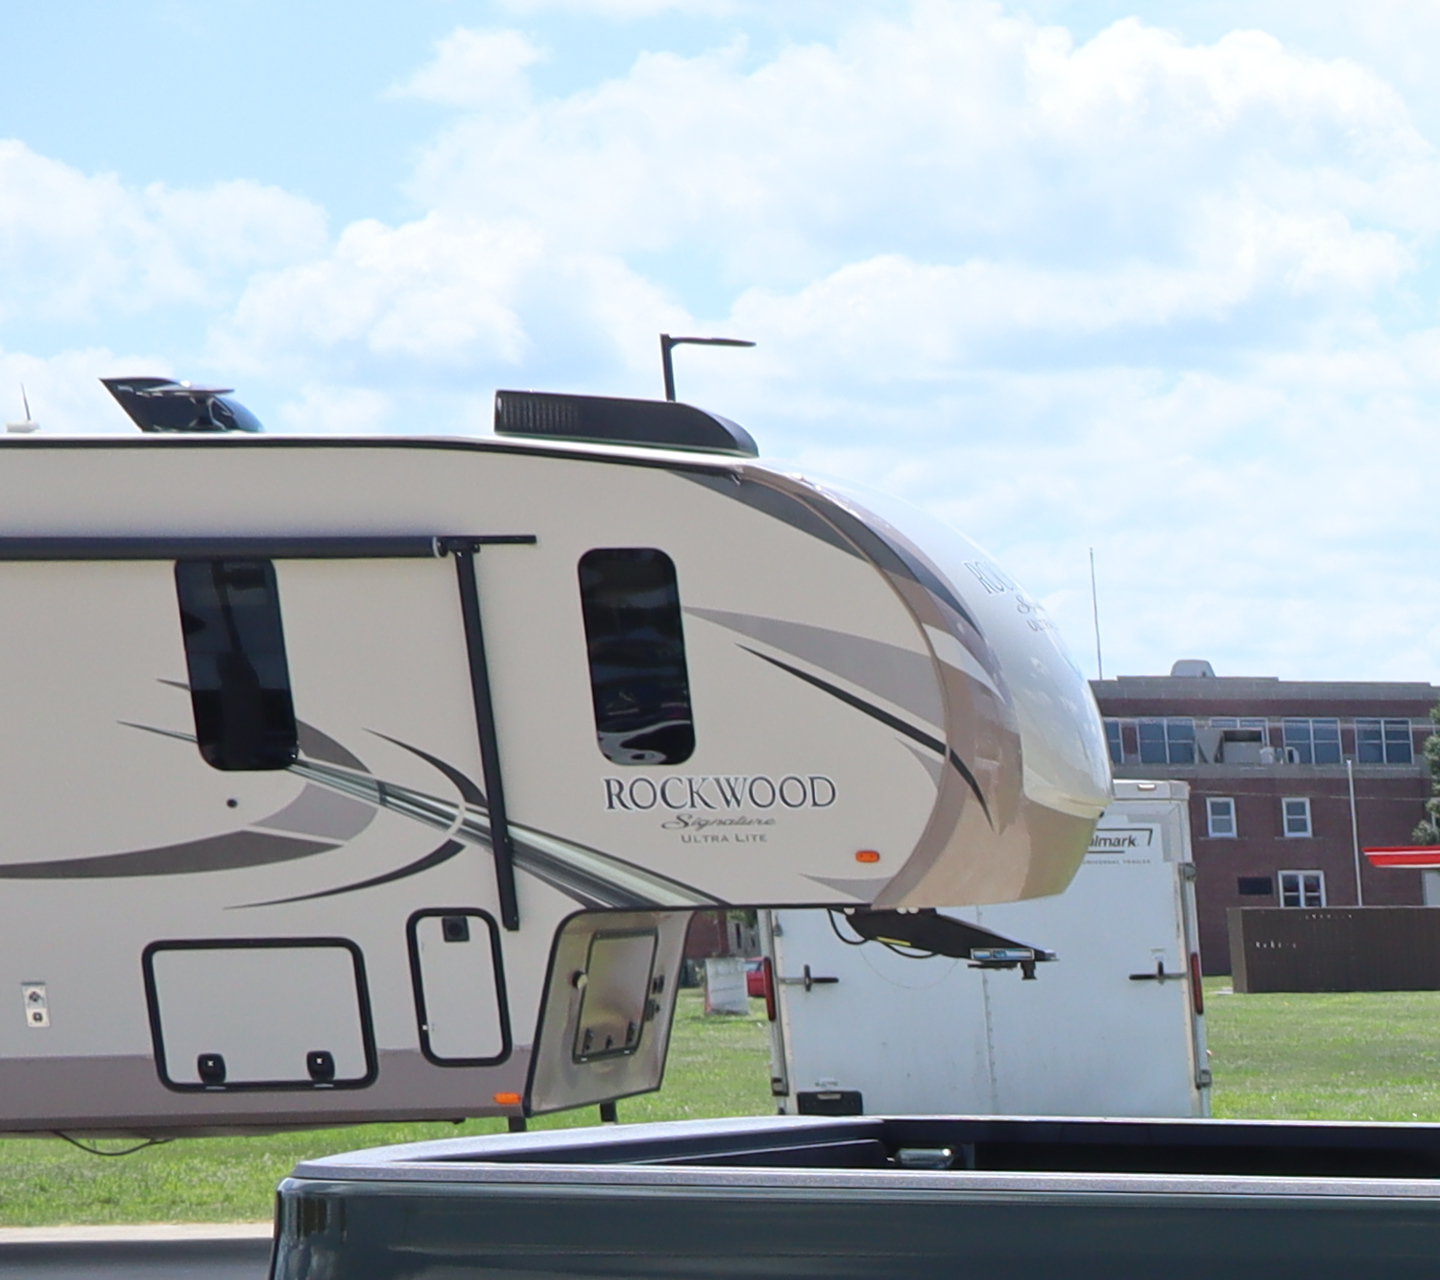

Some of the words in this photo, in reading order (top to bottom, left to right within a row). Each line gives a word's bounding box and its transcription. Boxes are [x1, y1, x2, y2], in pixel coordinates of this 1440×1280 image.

[603, 776, 836, 810] ROCKWOOD
[661, 813, 776, 831] Signature
[681, 834, 729, 843] ULTRA
[735, 833, 767, 842] LITE
